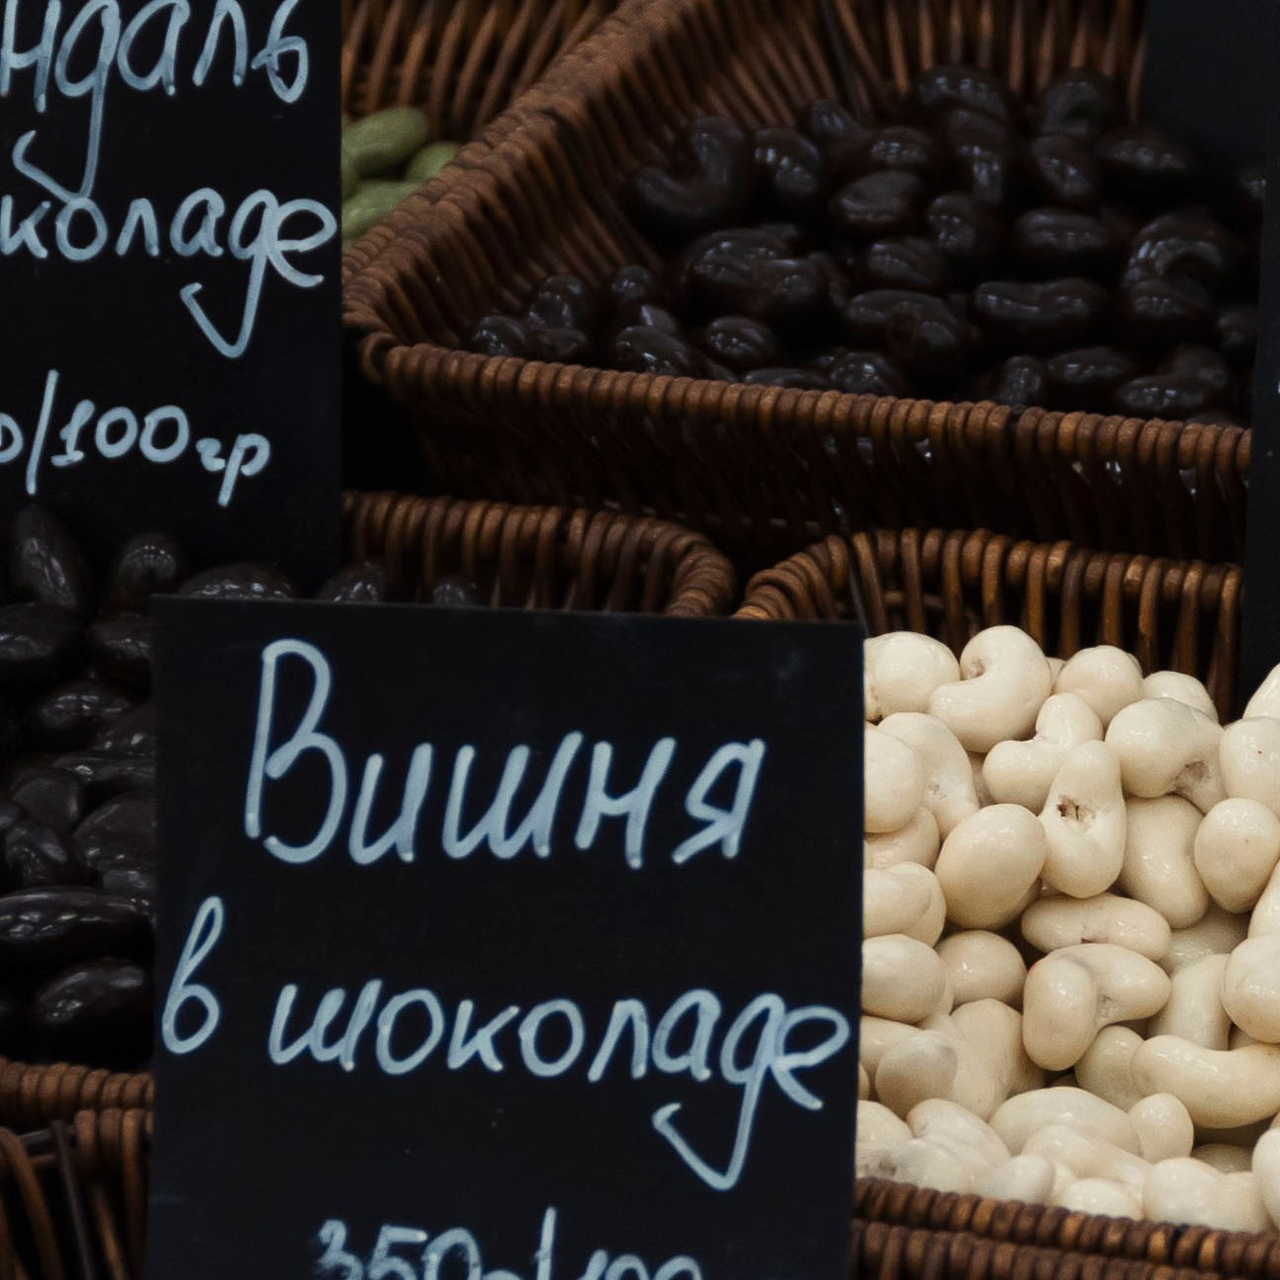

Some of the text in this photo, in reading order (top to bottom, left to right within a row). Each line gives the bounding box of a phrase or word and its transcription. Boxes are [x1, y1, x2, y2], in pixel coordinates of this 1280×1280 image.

[244, 637, 766, 870] Вишня
[161, 895, 852, 1192] в шоколаде
